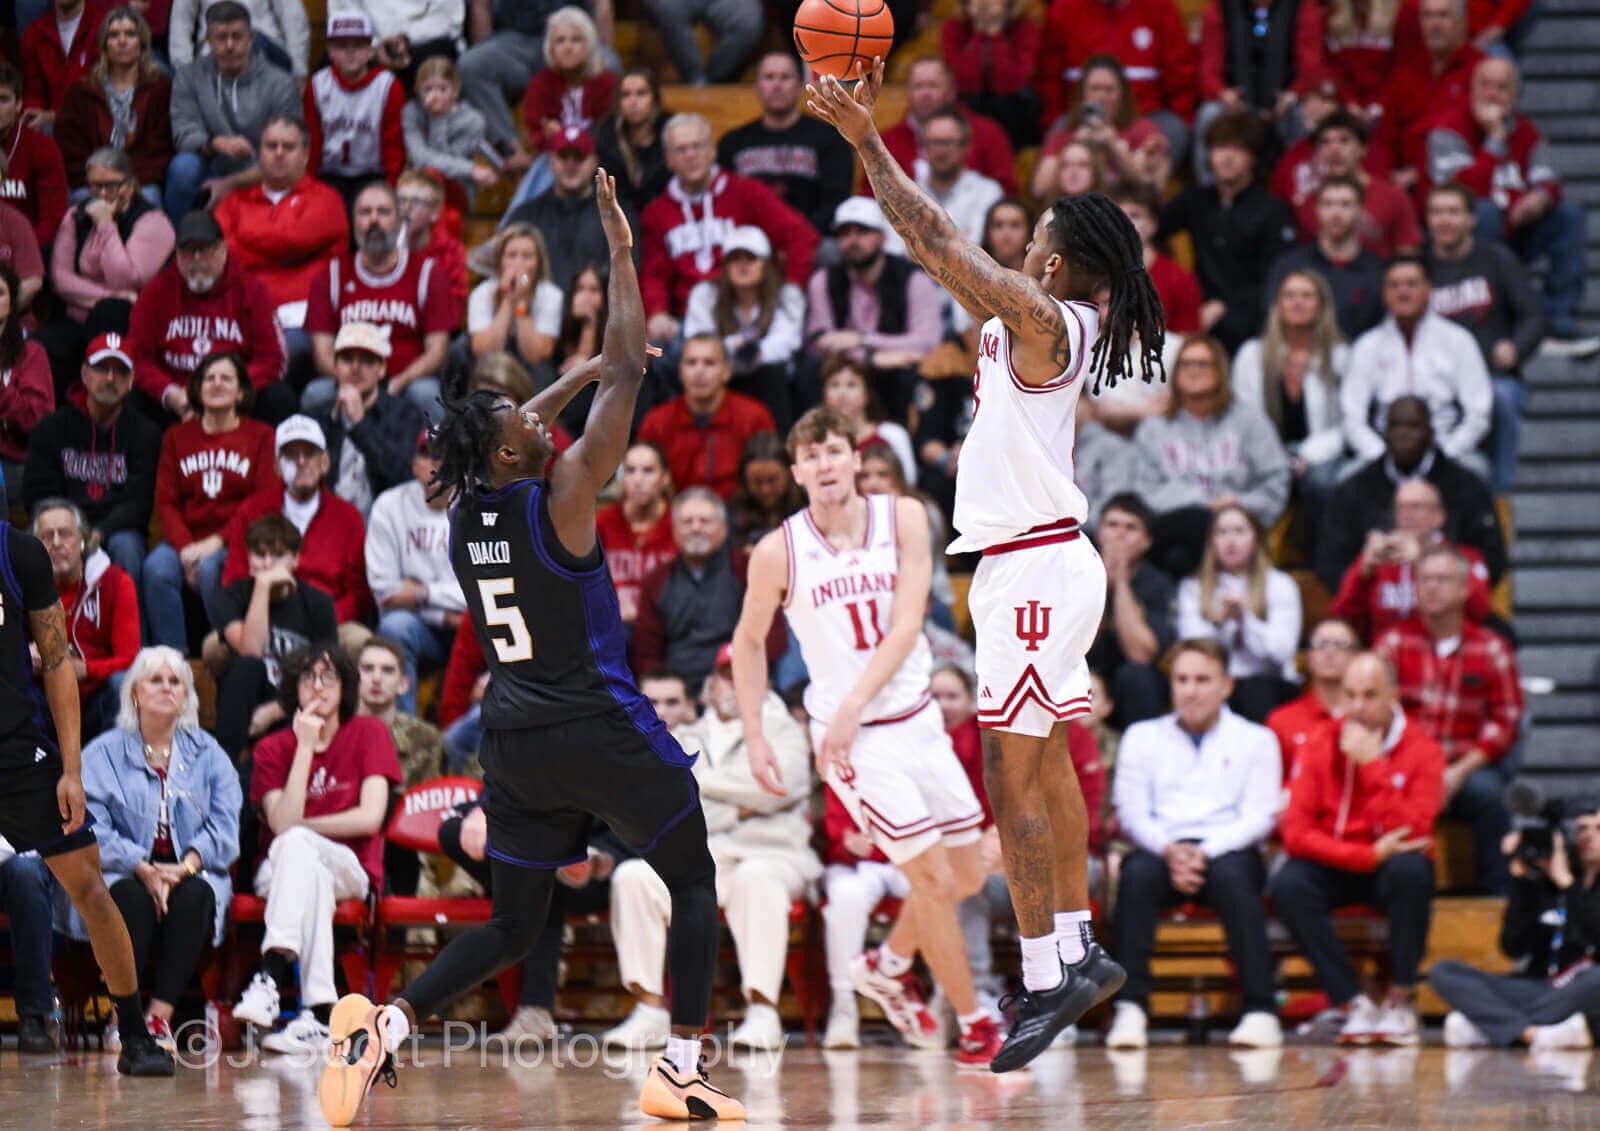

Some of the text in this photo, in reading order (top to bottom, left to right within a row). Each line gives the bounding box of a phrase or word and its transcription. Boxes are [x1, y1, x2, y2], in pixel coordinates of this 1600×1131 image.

[179, 449, 250, 478] INDIANA
[811, 572, 897, 608] INDIAN
[477, 577, 533, 662] 5
[845, 598, 885, 650] 11
